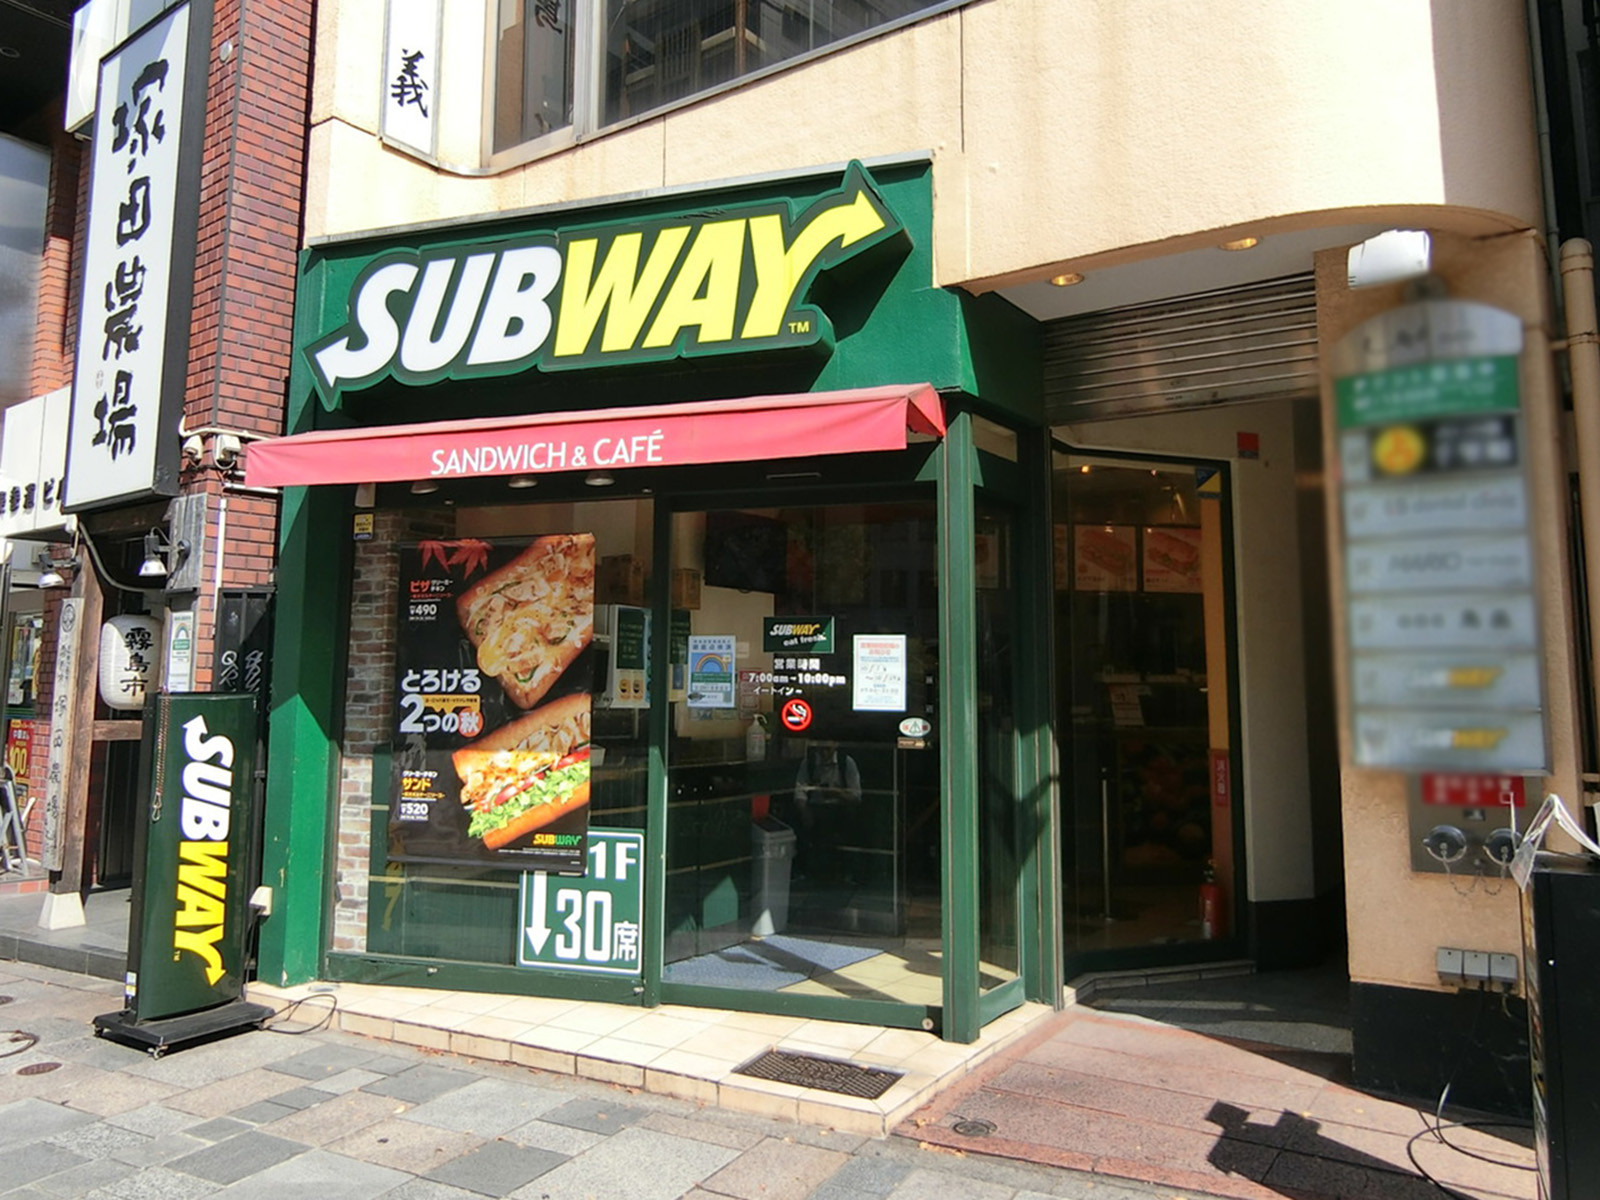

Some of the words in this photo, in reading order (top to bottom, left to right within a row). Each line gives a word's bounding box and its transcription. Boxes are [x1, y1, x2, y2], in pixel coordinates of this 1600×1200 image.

[92, 58, 169, 462] 塚田農場
[315, 189, 886, 387] SUBWAY
[430, 441, 567, 476] SANDWICH
[571, 445, 588, 467] &
[592, 429, 665, 466] CAFÉ
[769, 623, 821, 636] SUBWAY
[782, 637, 799, 647] eat
[120, 627, 154, 697] 霧島市
[401, 668, 482, 693] とろける
[401, 777, 432, 791] サンド
[174, 714, 236, 987] SUBWAY
[533, 833, 583, 846] SUBWAY
[585, 840, 639, 881] 1F
[555, 888, 639, 962] 30席
